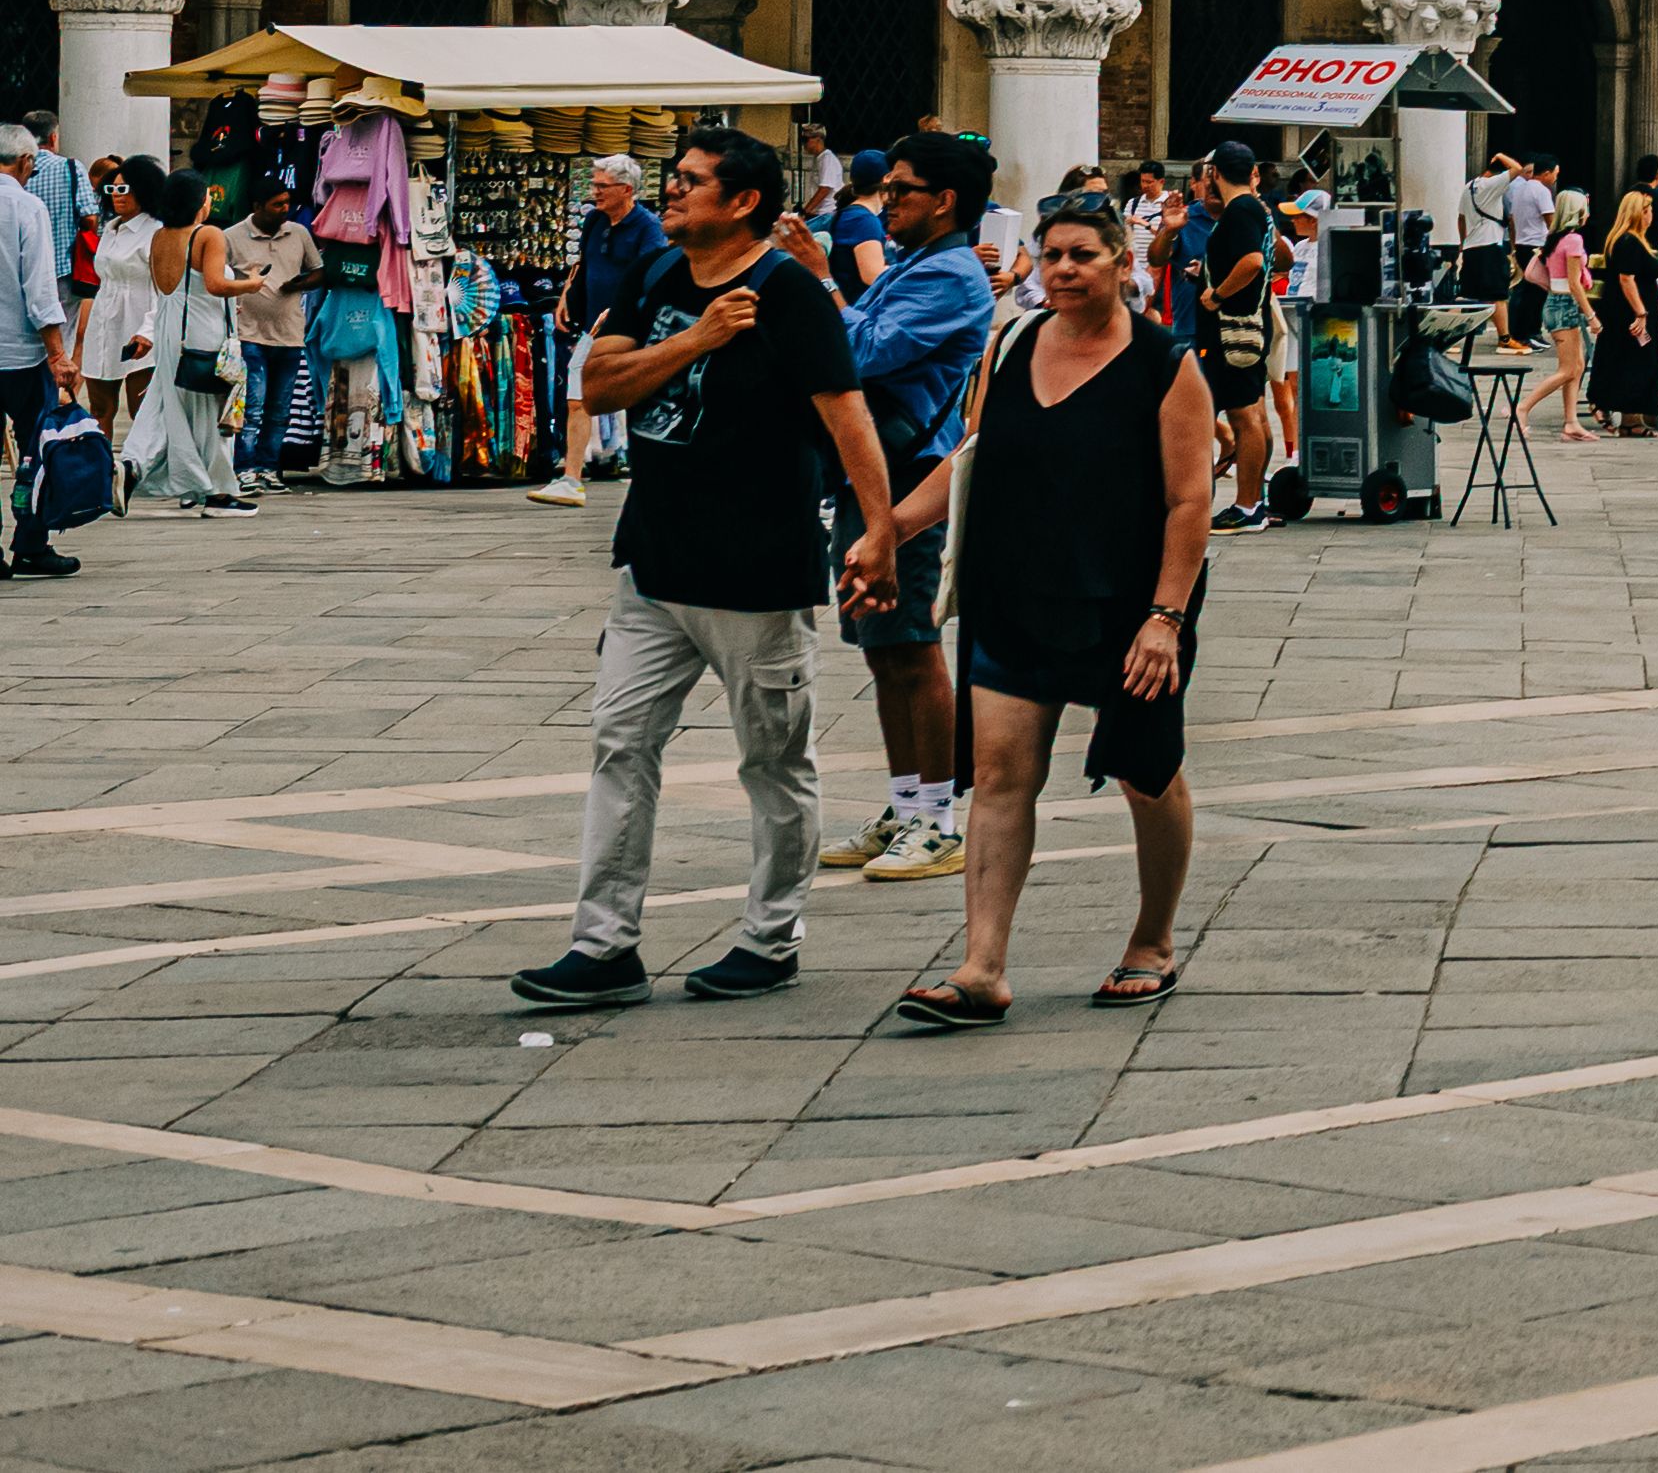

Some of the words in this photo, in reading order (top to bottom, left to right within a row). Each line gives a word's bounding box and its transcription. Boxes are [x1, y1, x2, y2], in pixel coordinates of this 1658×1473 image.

[1254, 58, 1397, 85] PHOTO
[1239, 88, 1319, 100] PROFESSIONAL
[1320, 91, 1376, 102] PORTRAIT
[1313, 101, 1328, 112] 3
